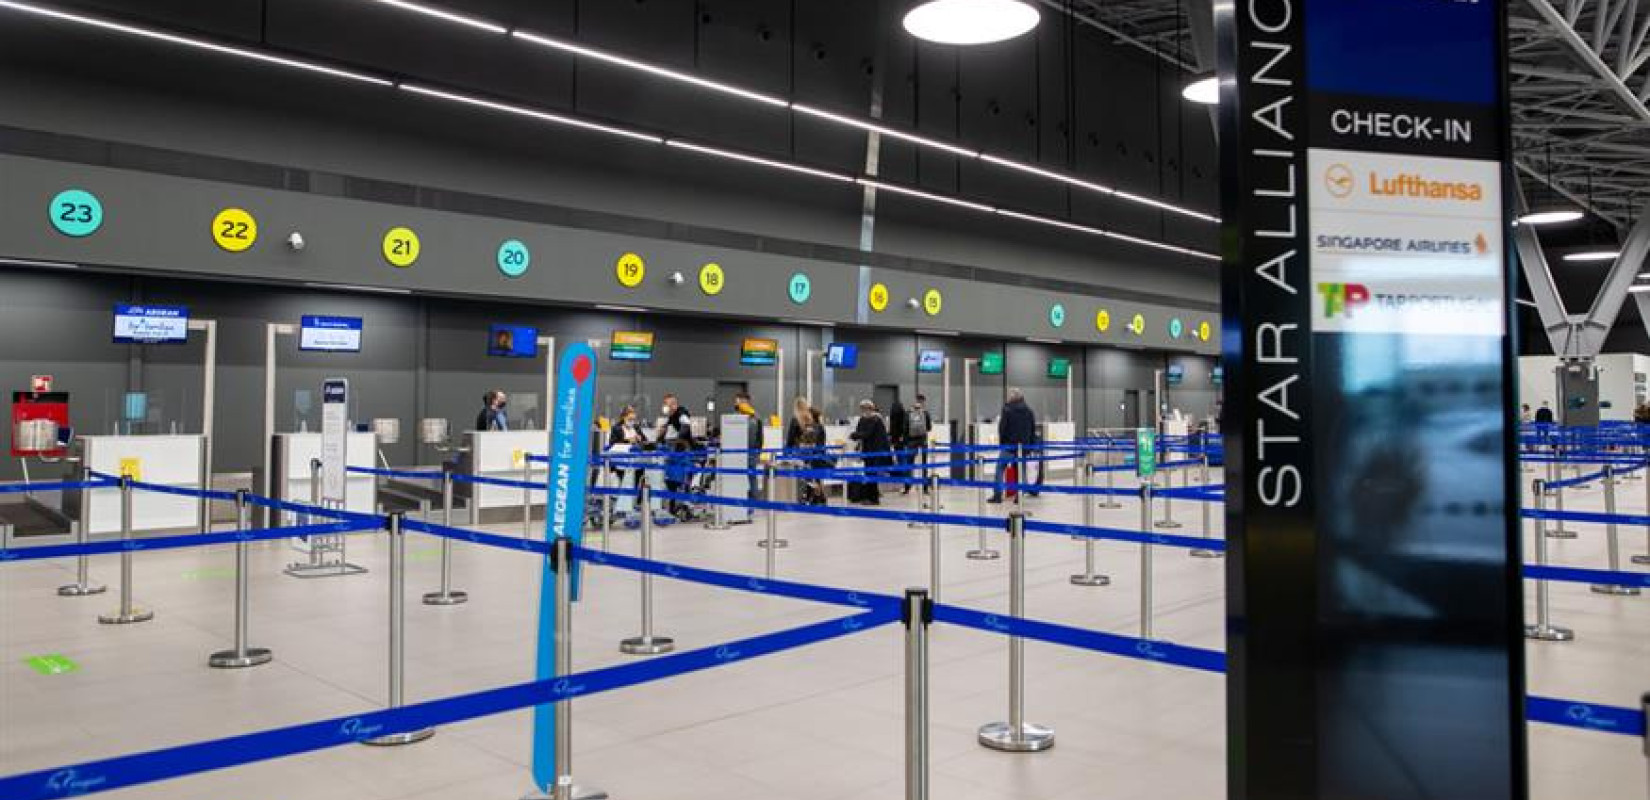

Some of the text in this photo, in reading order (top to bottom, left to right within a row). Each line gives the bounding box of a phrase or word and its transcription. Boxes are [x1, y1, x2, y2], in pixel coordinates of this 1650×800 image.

[1330, 109, 1473, 142] CHECK-IN
[1369, 171, 1482, 200] Lufthansa
[60, 203, 93, 223] 23
[220, 220, 249, 240] 22
[391, 239, 411, 255] 21
[503, 250, 525, 265] 20
[624, 263, 638, 277] 19
[706, 272, 719, 285] 18
[795, 282, 806, 294] 17
[874, 291, 884, 304] 16
[1256, 322, 1302, 507] STAR
[553, 387, 576, 536] AEGEAN for families
